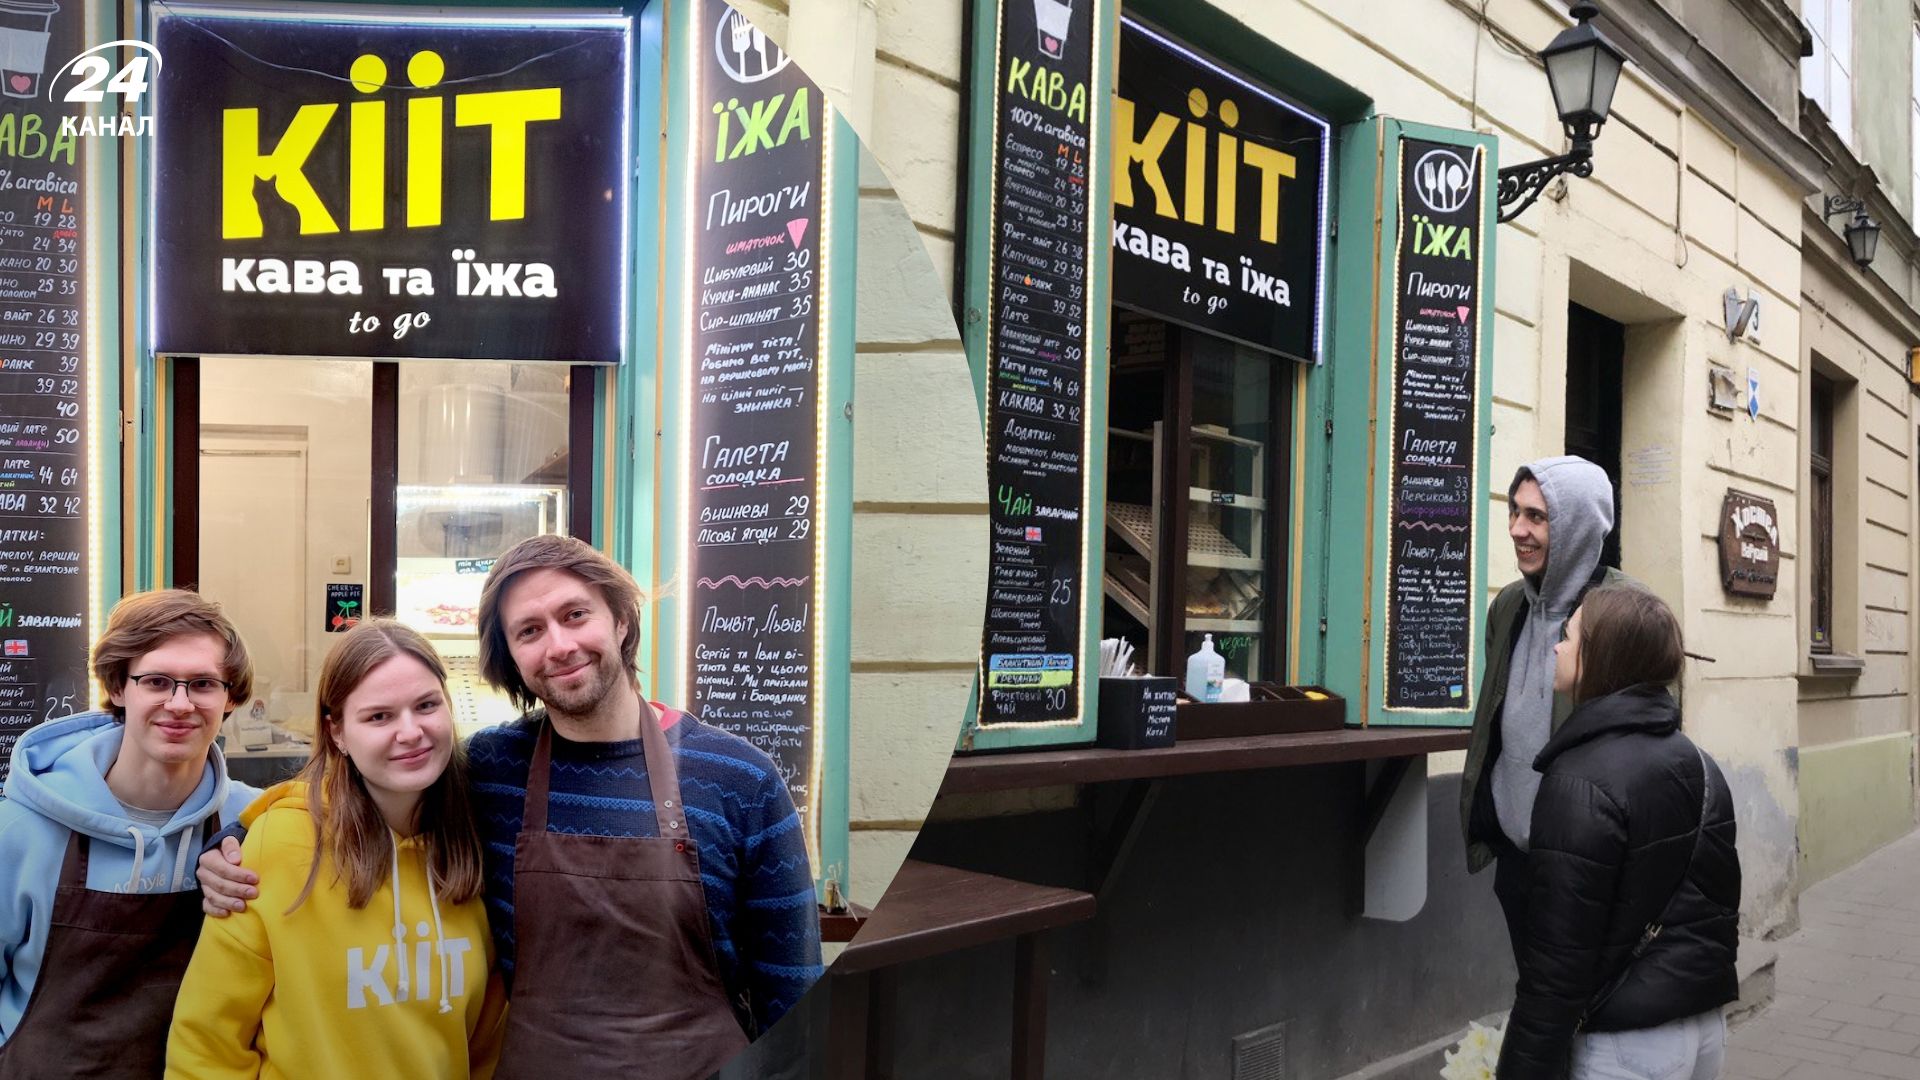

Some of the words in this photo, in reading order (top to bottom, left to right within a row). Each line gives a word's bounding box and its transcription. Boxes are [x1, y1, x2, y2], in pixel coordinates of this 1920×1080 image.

[1008, 56, 1086, 124] КАВА
[712, 87, 810, 163] ЇЖА
[1058, 143, 1069, 158] M
[1074, 150, 1082, 163] L
[1056, 157, 1068, 170] 19
[16, 171, 78, 195] arabica
[1071, 183, 1083, 197] 34
[37, 196, 53, 211] M
[61, 198, 73, 213] L
[1055, 195, 1067, 208] 20
[1070, 201, 1083, 215] 30
[34, 212, 51, 226] 19
[58, 214, 77, 229] 28
[1070, 219, 1083, 233] 35
[33, 237, 50, 251] 24
[58, 239, 77, 252] 34
[1412, 214, 1471, 260] ЇЖА
[1056, 241, 1068, 254] 26
[35, 257, 51, 271] 20
[57, 259, 78, 273] 30
[783, 249, 810, 271] 30
[223, 258, 362, 294] кава
[383, 267, 434, 295] та
[452, 249, 557, 298] їжа
[1053, 260, 1068, 275] 29
[1070, 264, 1084, 280] 39
[38, 279, 54, 293] 25
[59, 280, 78, 295] 35
[788, 271, 812, 292] 35
[1202, 257, 1230, 286] та
[1239, 255, 1291, 307] їжа
[1069, 284, 1082, 299] 39
[1183, 286, 1200, 304] to
[1207, 295, 1228, 314] go
[790, 295, 812, 318] 35
[1053, 300, 1066, 314] 39
[1069, 304, 1081, 319] 52
[38, 309, 56, 323] 26
[62, 310, 79, 325] 38
[349, 312, 380, 334] to
[393, 311, 431, 339] go
[1066, 322, 1082, 338] 40
[35, 332, 56, 348] 29
[60, 333, 80, 350] 39
[1064, 345, 1082, 361] 50
[59, 356, 79, 373] 39
[35, 378, 55, 393] 39
[60, 379, 78, 394] 52
[1067, 381, 1079, 396] 64
[56, 401, 79, 417] 40
[1052, 403, 1065, 419] 32
[1069, 406, 1080, 422] 42
[54, 428, 80, 444] 50
[39, 466, 54, 485] 44
[61, 468, 78, 486] 64
[38, 496, 57, 514] 32
[64, 496, 81, 515] 42
[785, 495, 809, 515] 29
[788, 518, 810, 539] 29
[1050, 578, 1072, 605] 25
[1046, 688, 1066, 711] 30
